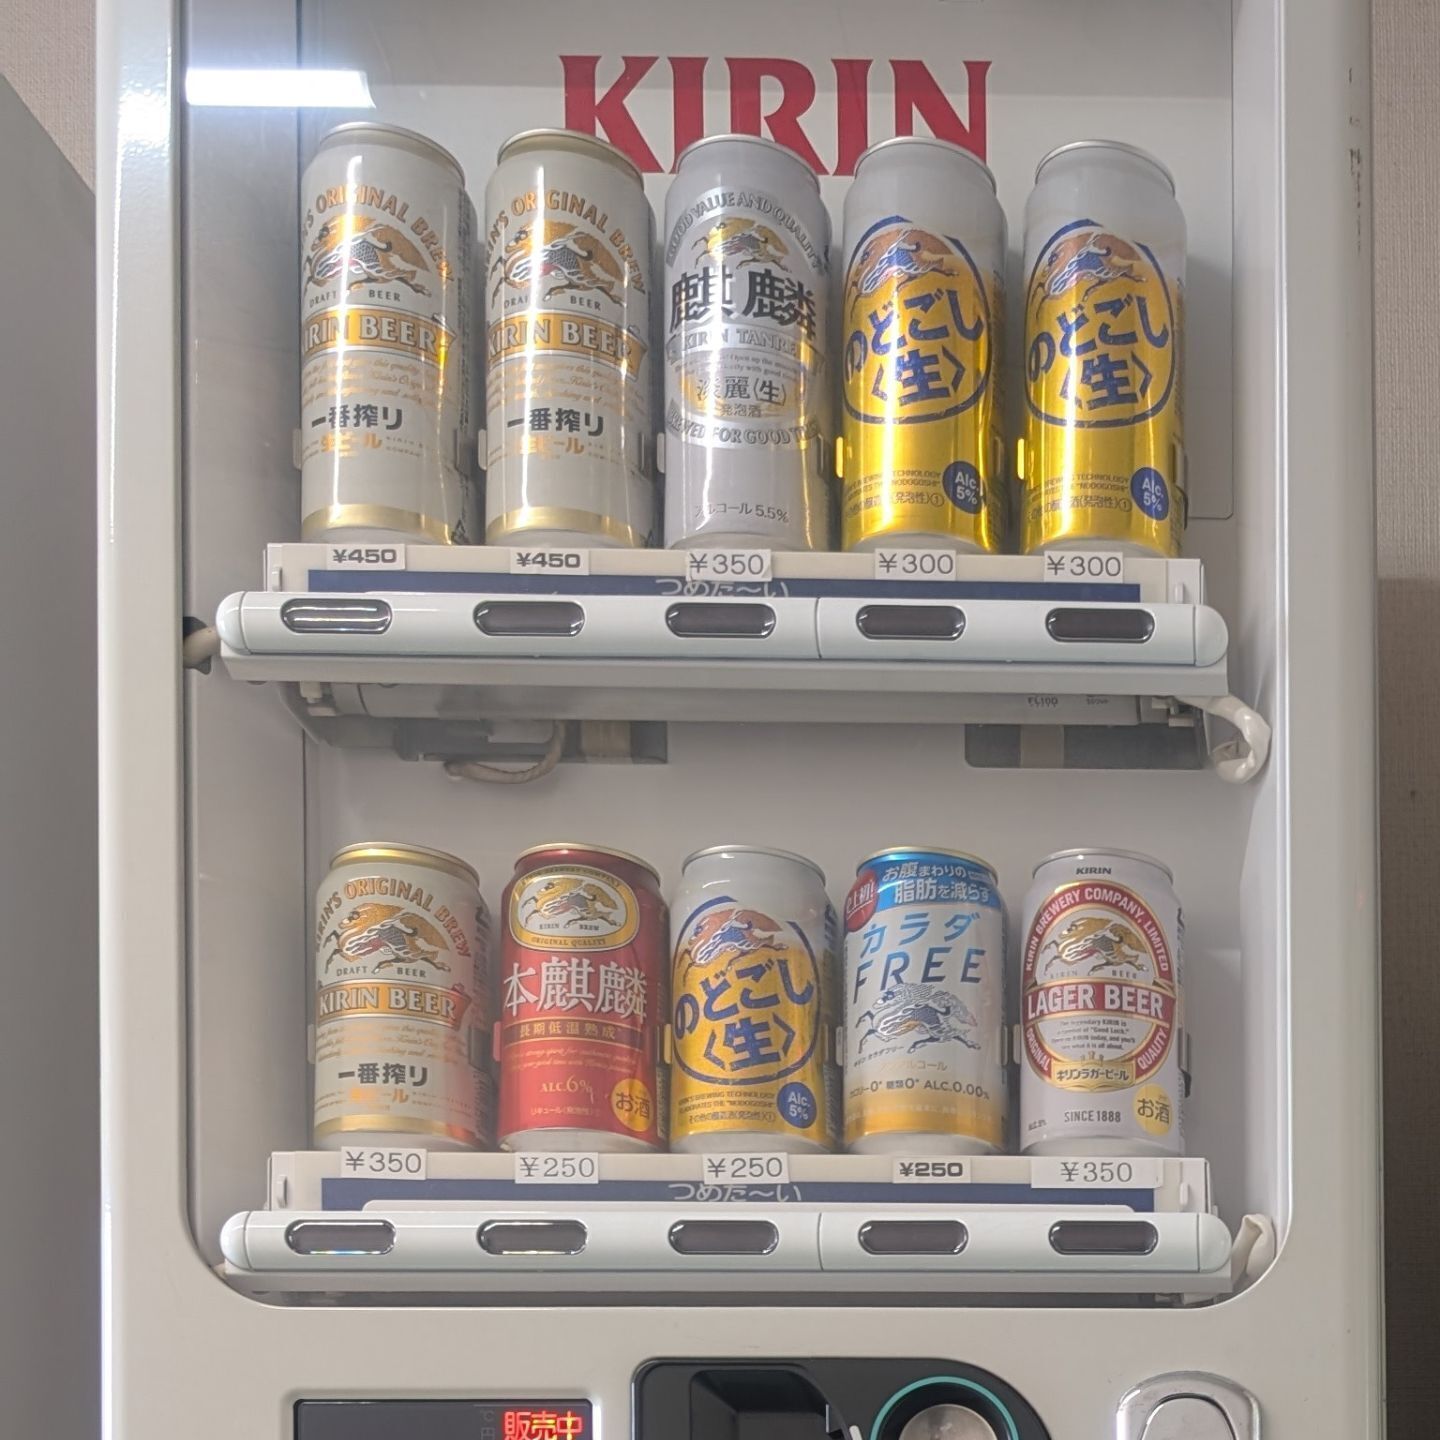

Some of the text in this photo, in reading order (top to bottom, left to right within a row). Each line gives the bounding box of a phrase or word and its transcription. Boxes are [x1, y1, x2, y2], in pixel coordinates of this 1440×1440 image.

[559, 55, 992, 176] KIRIN
[368, 289, 400, 302] BEER
[570, 295, 601, 311] BEER
[359, 314, 436, 355] BEER
[845, 289, 984, 383] のどごし
[1029, 290, 1169, 383] のどごし
[312, 403, 403, 430] 一番搾り
[507, 407, 604, 437] 一番搾り
[956, 486, 978, 505] 5%
[333, 550, 397, 564] ¥450
[517, 553, 581, 568] ¥450
[689, 553, 764, 575] ¥350
[879, 552, 954, 575] ¥300
[1047, 555, 1122, 576] ¥300
[881, 861, 967, 882] お腹まわりの
[1075, 867, 1112, 875] KIRIN
[894, 878, 992, 904] 脂肪を減らす
[344, 877, 435, 913] ORIGINAL
[434, 905, 472, 958] BREW
[1025, 887, 1169, 972] KIRIN BREWERY COMPANY, LIMITED
[860, 911, 981, 959] カラダ
[336, 966, 427, 978] DRAFT BEER
[853, 946, 987, 1005] FREE
[319, 986, 458, 1021] KIRIN BEER
[502, 956, 649, 1026] 本麒麟
[674, 958, 815, 1041] のどごし
[1027, 984, 1163, 1020] LAGER BEER
[1025, 1027, 1050, 1072] ORIGINAL
[1136, 1027, 1168, 1071] QUALITY
[338, 1062, 428, 1087] 一番搾り
[1056, 1068, 1130, 1082] キリンラガービール
[616, 1091, 650, 1119] お酒
[788, 1092, 811, 1108] Alc.
[789, 1105, 809, 1120] 5%
[1137, 1097, 1170, 1125] お酒
[1064, 1110, 1121, 1123] SINCE 1888
[345, 1152, 422, 1174] ¥350
[519, 1156, 595, 1178] ¥250
[707, 1157, 783, 1178] ¥250
[899, 1162, 963, 1178] ¥250
[1060, 1161, 1133, 1183] ¥350
[503, 1410, 583, 1440] 販売中
